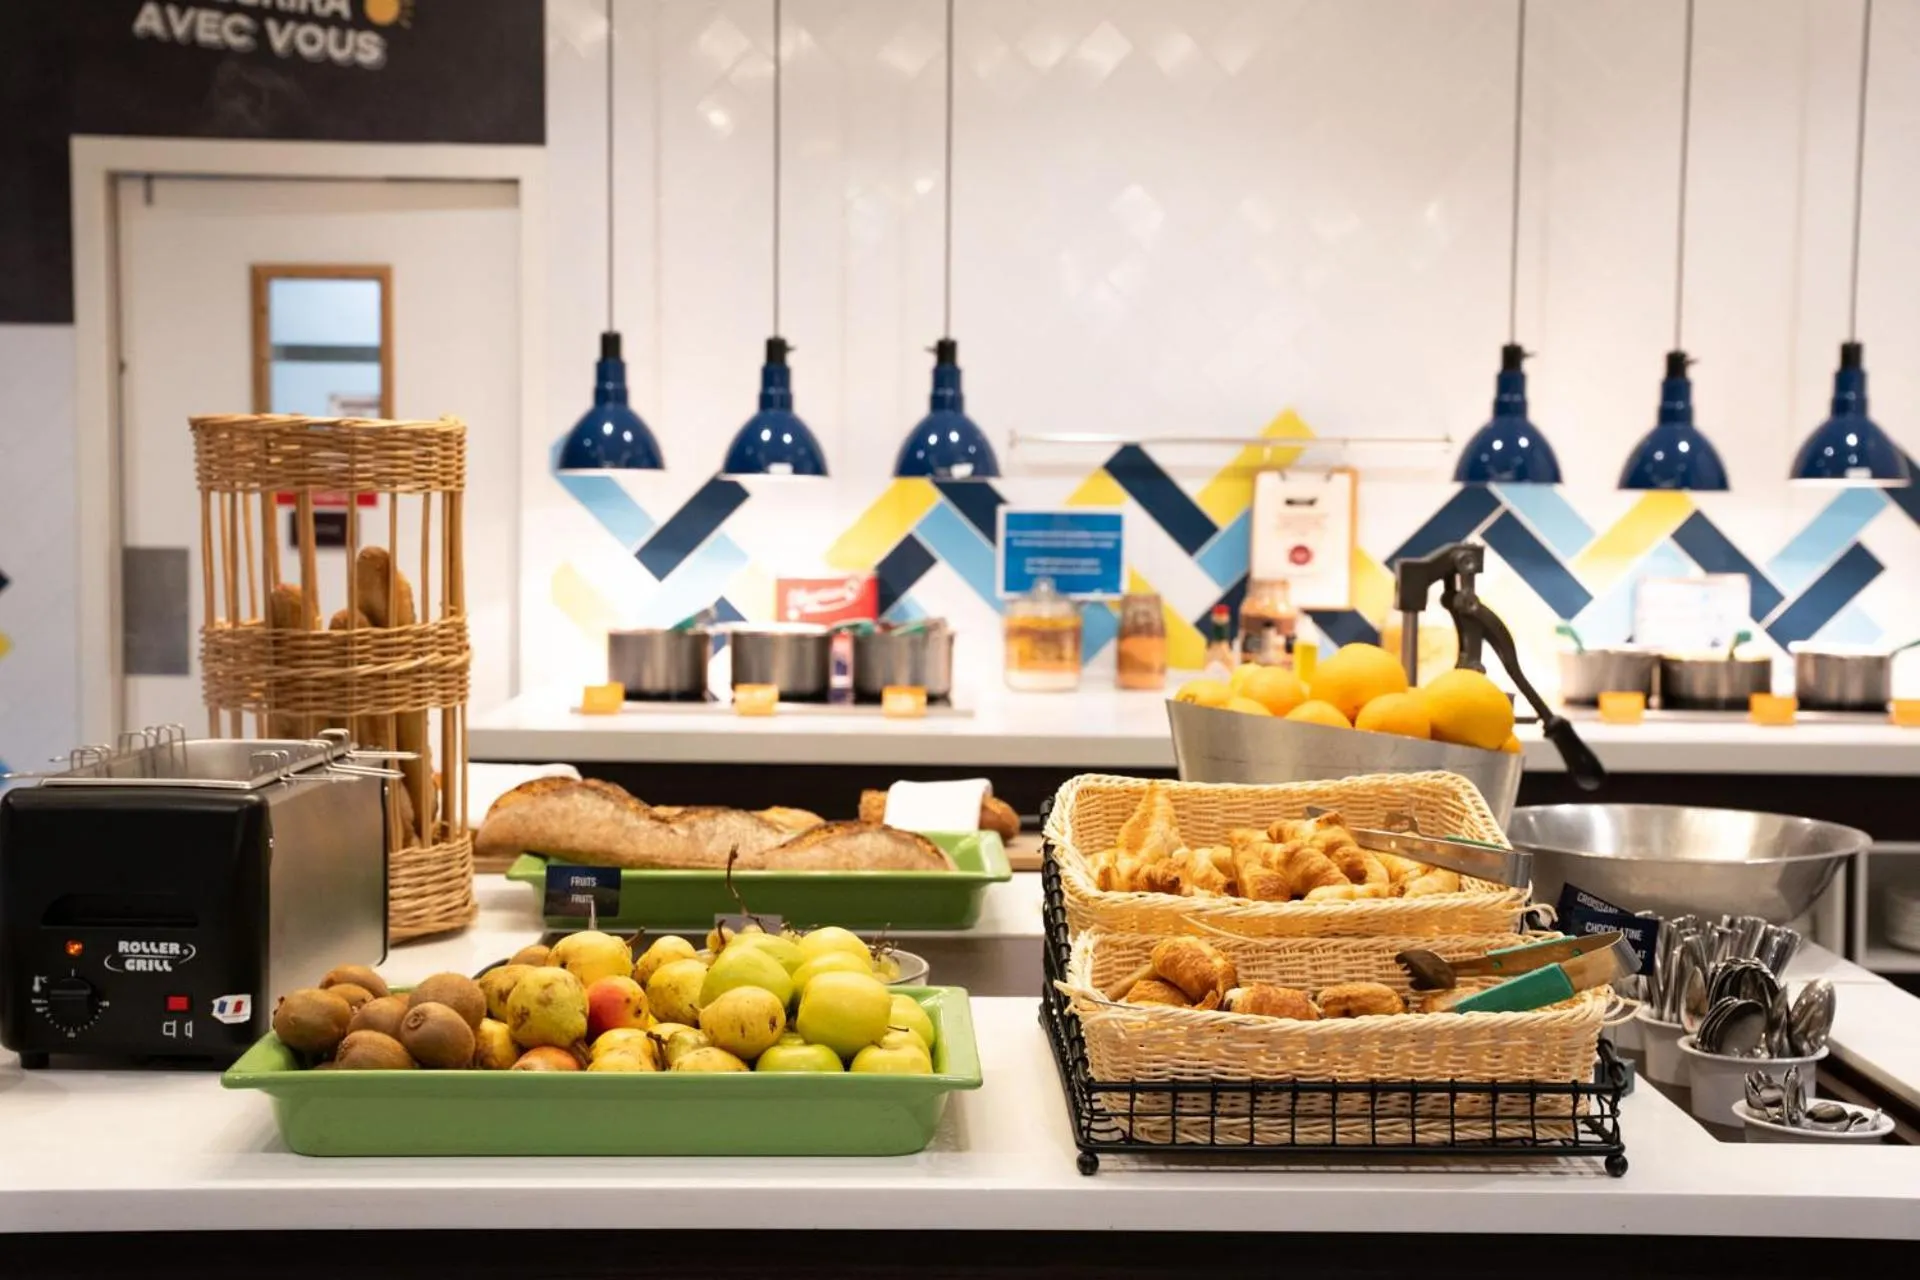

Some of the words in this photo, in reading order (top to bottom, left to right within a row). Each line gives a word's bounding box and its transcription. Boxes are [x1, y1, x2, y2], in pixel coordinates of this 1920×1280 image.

[132, 2, 256, 50] AVEC
[264, 17, 387, 70] VOUS
[570, 876, 597, 887] FRUITS
[1585, 922, 1643, 941] CHOCOLTINE
[118, 941, 180, 954] ROLLER
[125, 959, 172, 972] GRILL
